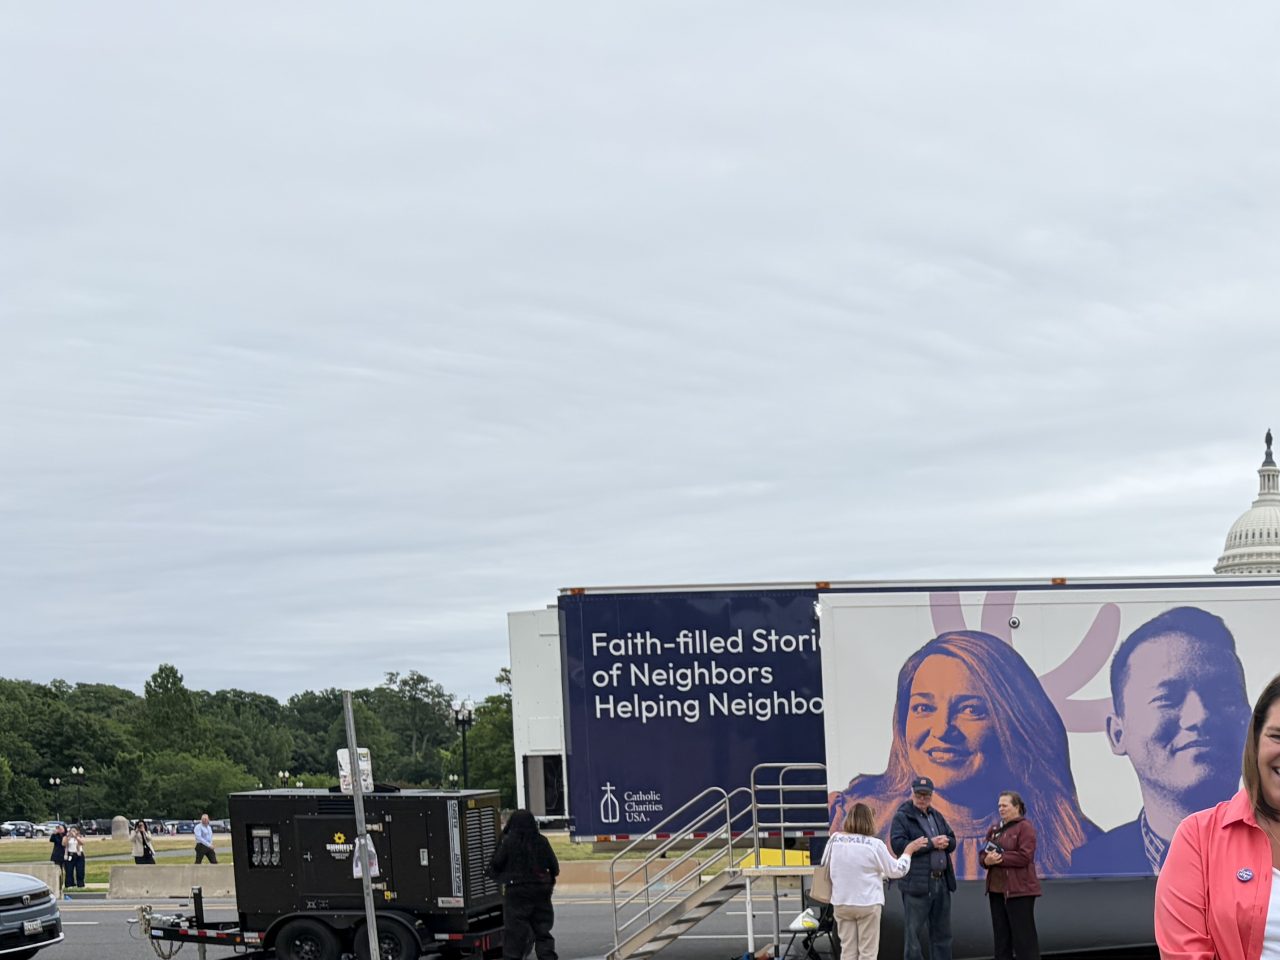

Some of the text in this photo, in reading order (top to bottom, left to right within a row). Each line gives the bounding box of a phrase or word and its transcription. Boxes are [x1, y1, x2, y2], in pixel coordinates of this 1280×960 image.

[592, 629, 743, 656] Faith-filled
[592, 661, 773, 691] of Neighbors
[595, 694, 699, 723] Helping
[624, 791, 661, 801] Catholic
[625, 802, 663, 812] Charities
